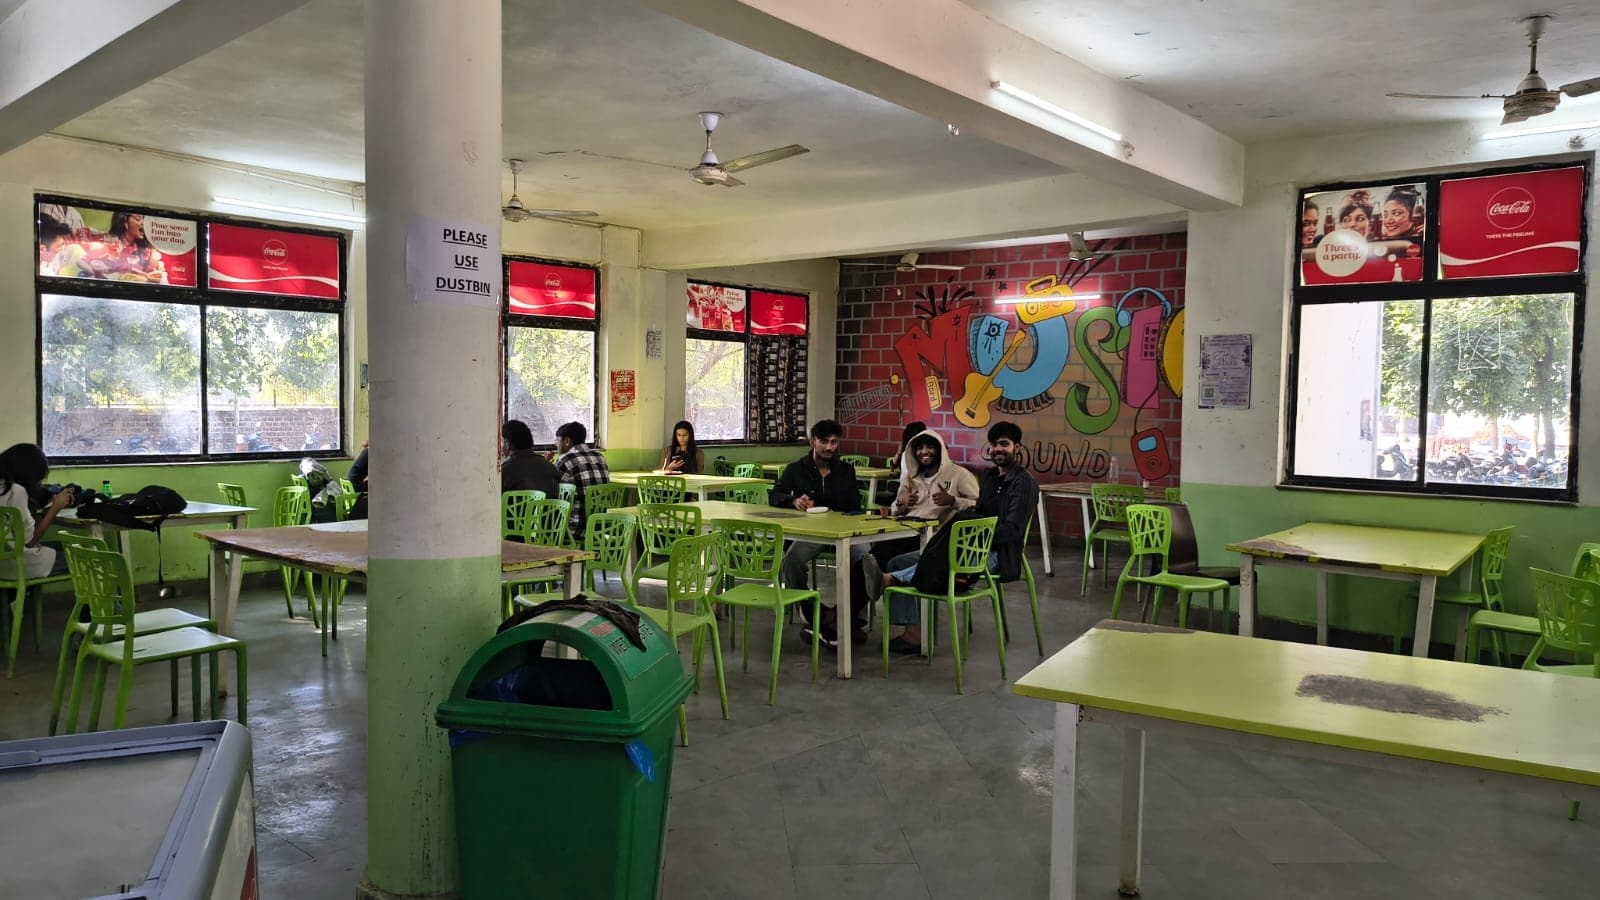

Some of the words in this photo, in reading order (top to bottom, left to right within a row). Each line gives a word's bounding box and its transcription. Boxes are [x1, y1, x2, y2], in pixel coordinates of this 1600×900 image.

[151, 221, 168, 229] Pour
[166, 229, 181, 237] into
[443, 228, 488, 247] PLEASE
[454, 254, 479, 269] USE
[1331, 252, 1361, 262] party.
[436, 276, 490, 294] DUSTBIN
